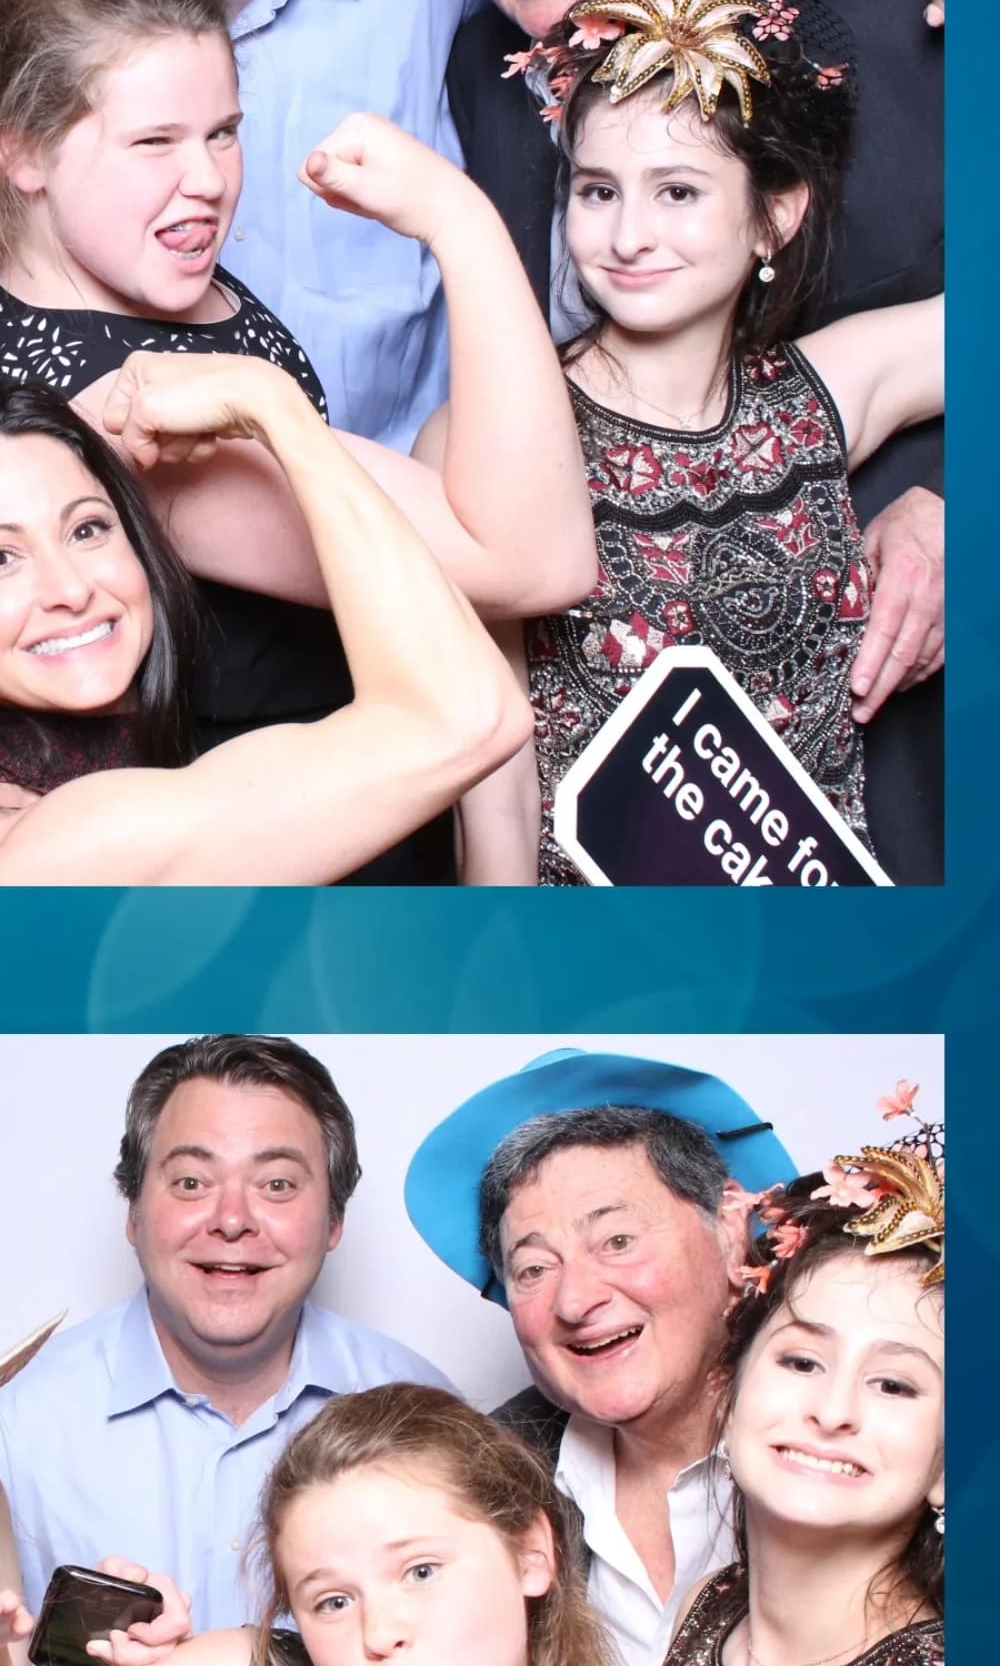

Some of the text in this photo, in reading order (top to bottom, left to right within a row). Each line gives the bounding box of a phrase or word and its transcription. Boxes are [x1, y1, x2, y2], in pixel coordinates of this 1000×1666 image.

[642, 733, 774, 887] the cak
[672, 687, 840, 887] I came fo
